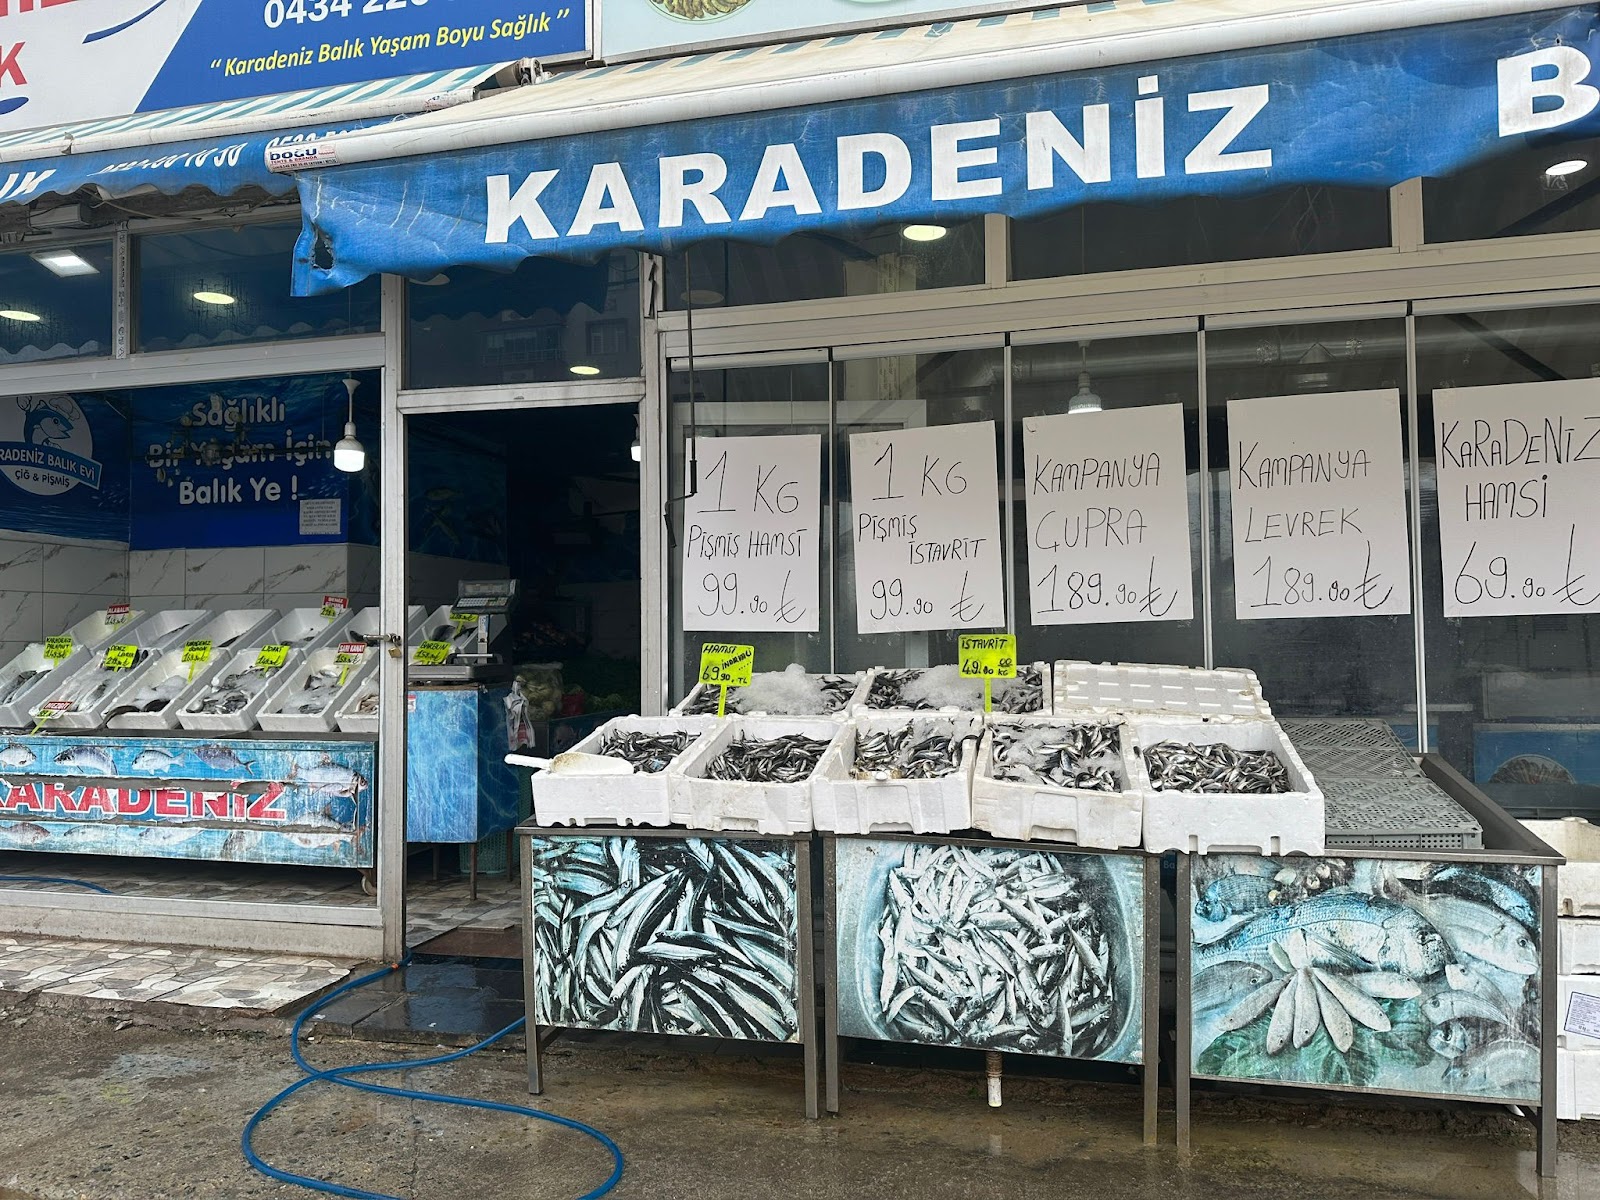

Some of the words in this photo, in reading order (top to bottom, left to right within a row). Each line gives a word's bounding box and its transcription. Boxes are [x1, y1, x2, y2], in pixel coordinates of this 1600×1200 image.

[224, 48, 313, 77] Karadeniz
[317, 38, 364, 64] Balık
[370, 32, 431, 58] Yaşam
[436, 24, 485, 49] Boyu
[490, 14, 550, 41] Sağlık
[484, 75, 1273, 243] KARADENİZ
[192, 396, 285, 431] Sağlıklı
[15, 468, 30, 480] ÇİĞ
[32, 472, 39, 481] &
[42, 472, 70, 488] PİŞMİŞ
[47, 454, 77, 473] BALIK
[79, 463, 95, 481] EVİ
[696, 450, 737, 514] 1
[753, 464, 799, 515] KG
[871, 442, 905, 501] 1
[921, 454, 968, 498] KG
[1033, 452, 1161, 496] KAMPANYA
[1238, 440, 1372, 490] KAMPANYA
[179, 477, 242, 504] Balık
[250, 477, 281, 501] Ye
[1465, 474, 1549, 522] HAMSİ
[1244, 506, 1363, 543] LEVREK
[869, 577, 934, 621] 99.90
[961, 637, 1008, 650] İSTAVRİT
